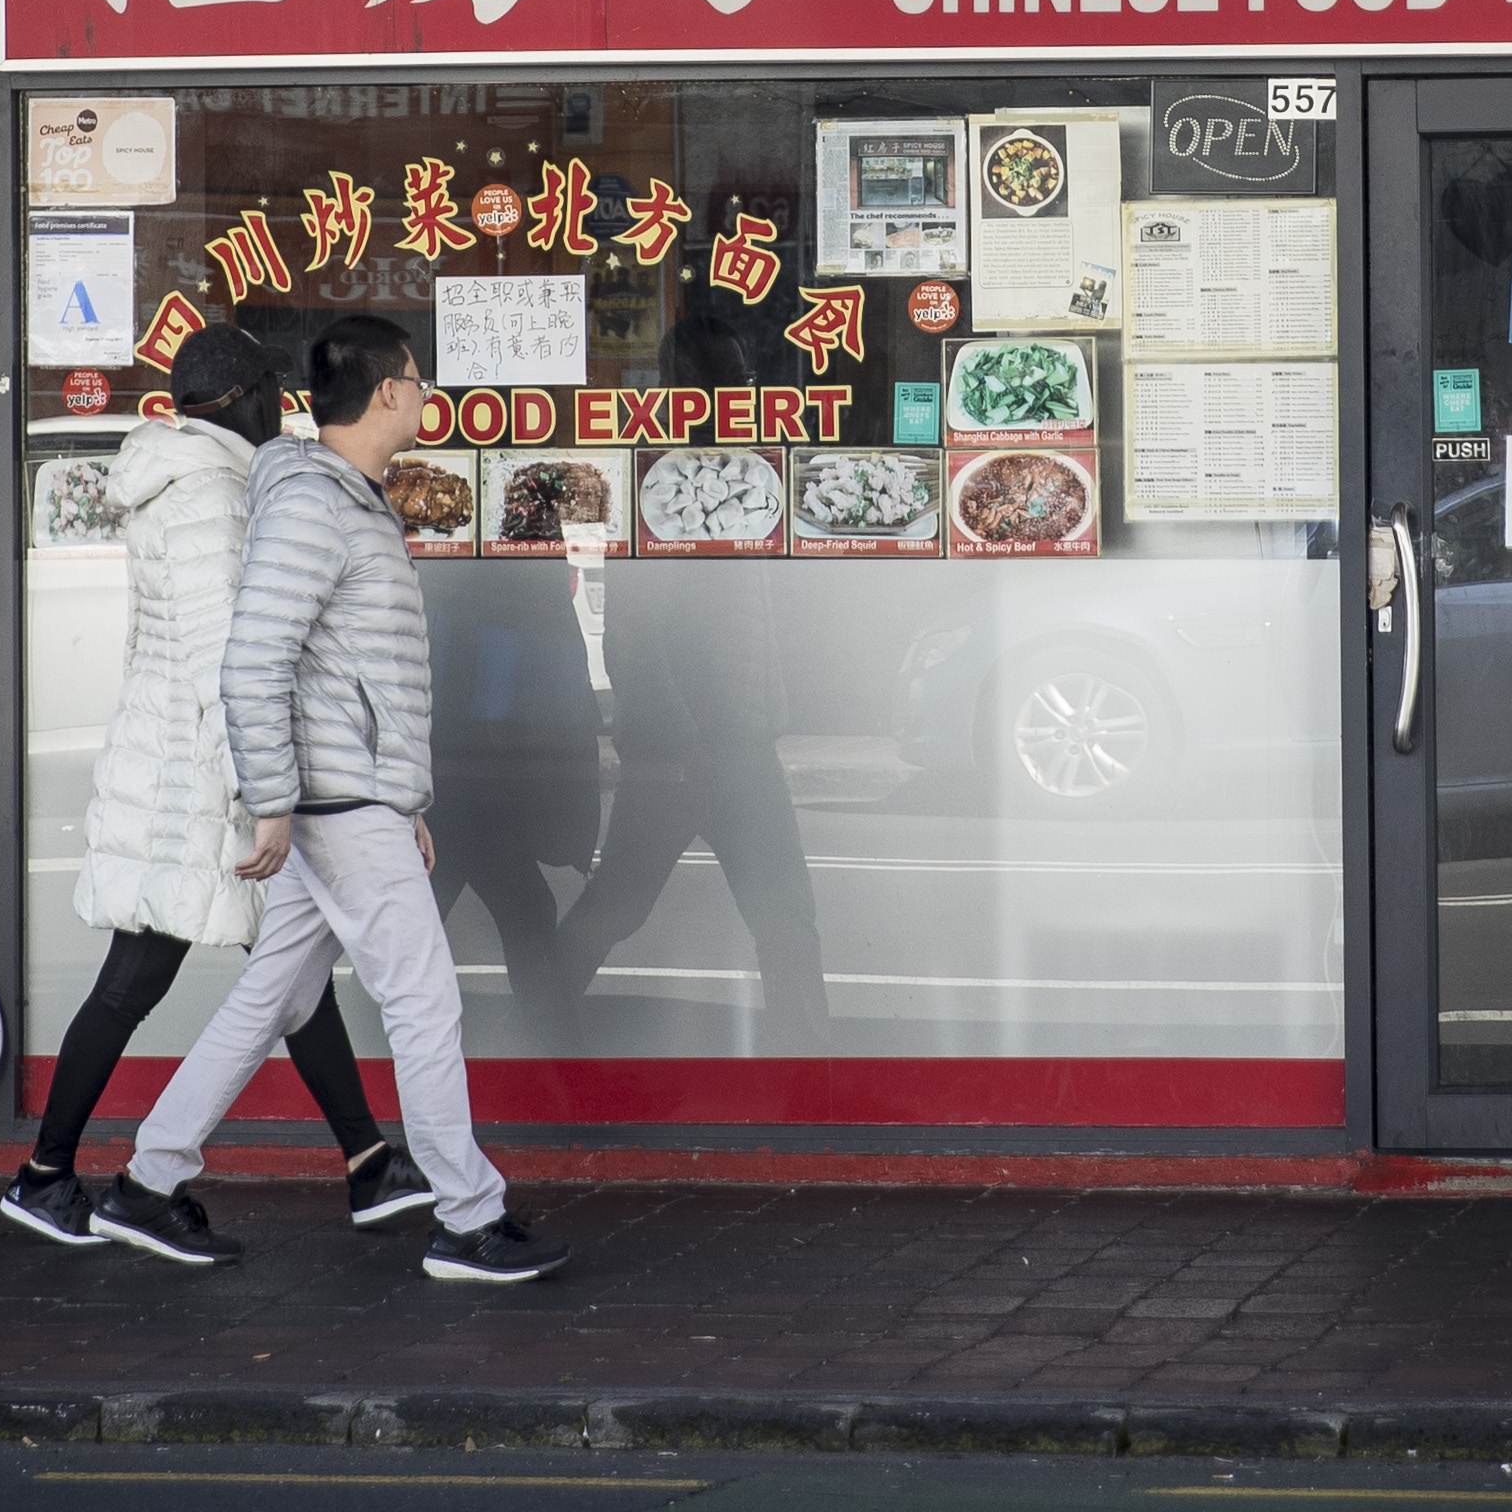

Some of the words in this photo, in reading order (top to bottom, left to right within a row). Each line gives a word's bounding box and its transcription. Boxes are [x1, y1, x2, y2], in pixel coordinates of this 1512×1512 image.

[1270, 85, 1336, 114] 557
[39, 124, 75, 137] Cheap
[69, 135, 93, 146] Eats
[1168, 117, 1295, 157] OPEN
[39, 138, 92, 168] Top
[480, 196, 501, 204] LOVE
[502, 196, 513, 204] US
[477, 210, 505, 227] yelp
[850, 212, 865, 220] The
[866, 212, 883, 220] chef
[884, 212, 937, 220] recommends
[1158, 212, 1191, 224] HOUSE
[50, 222, 76, 232] premises
[77, 221, 108, 230] certificate
[921, 285, 946, 293] PEOPLE
[58, 280, 101, 324] A
[917, 292, 939, 300] LOVE
[939, 292, 951, 300] US
[913, 306, 942, 322] yelp
[73, 371, 99, 379] PEOPLE
[70, 378, 90, 387] LOVE
[91, 378, 103, 387] US
[67, 391, 92, 408] yelp
[1442, 392, 1471, 400] WHERE
[414, 388, 557, 446] OOD
[574, 383, 852, 445] EXPERT
[903, 405, 931, 413] WHERE
[990, 431, 1023, 442] Cabbage
[1024, 431, 1039, 440] with
[1041, 431, 1064, 440] Garlic
[1435, 442, 1486, 459] PUSH
[490, 541, 529, 553] Spare-rib
[530, 541, 548, 553] with
[647, 540, 697, 553] Damplings
[801, 539, 850, 552] Deep-Fried
[851, 539, 877, 551] Squid
[956, 541, 973, 553] Hot
[974, 541, 983, 553] &
[985, 541, 1013, 554] Spicy
[1013, 541, 1036, 552] Beef
